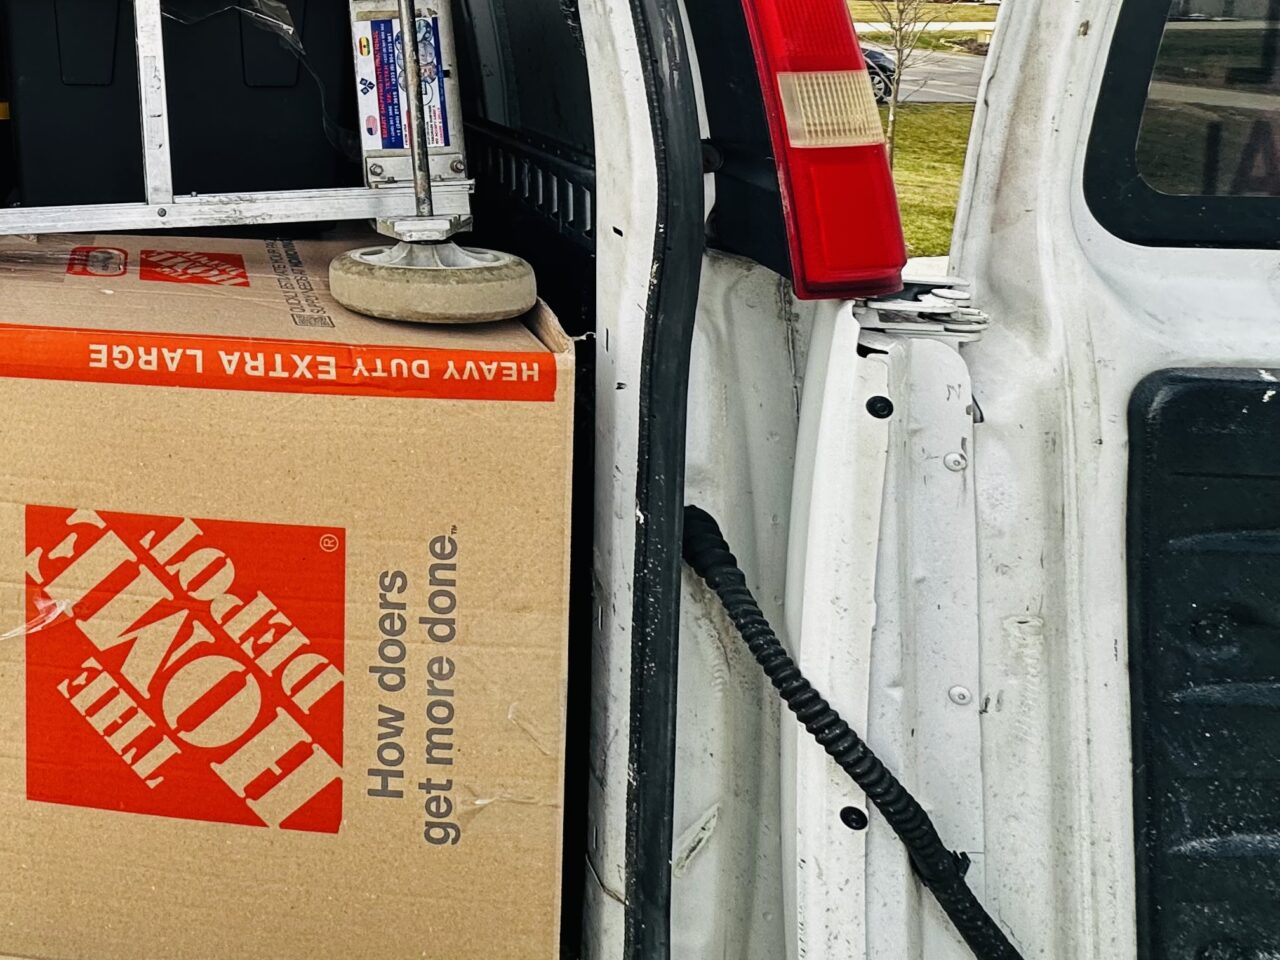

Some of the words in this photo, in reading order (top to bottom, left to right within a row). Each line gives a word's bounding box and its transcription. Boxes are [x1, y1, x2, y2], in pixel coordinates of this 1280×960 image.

[89, 344, 203, 373] LARGE
[218, 350, 337, 380] EXTRA
[352, 357, 430, 379] DUTY
[442, 360, 539, 382] HEAVY
[138, 517, 344, 715] DEPOT
[368, 570, 408, 692] doers
[25, 508, 344, 829] HOME
[425, 656, 455, 765] more
[57, 656, 182, 789] THE
[367, 704, 405, 798] How
[418, 777, 461, 846] get
